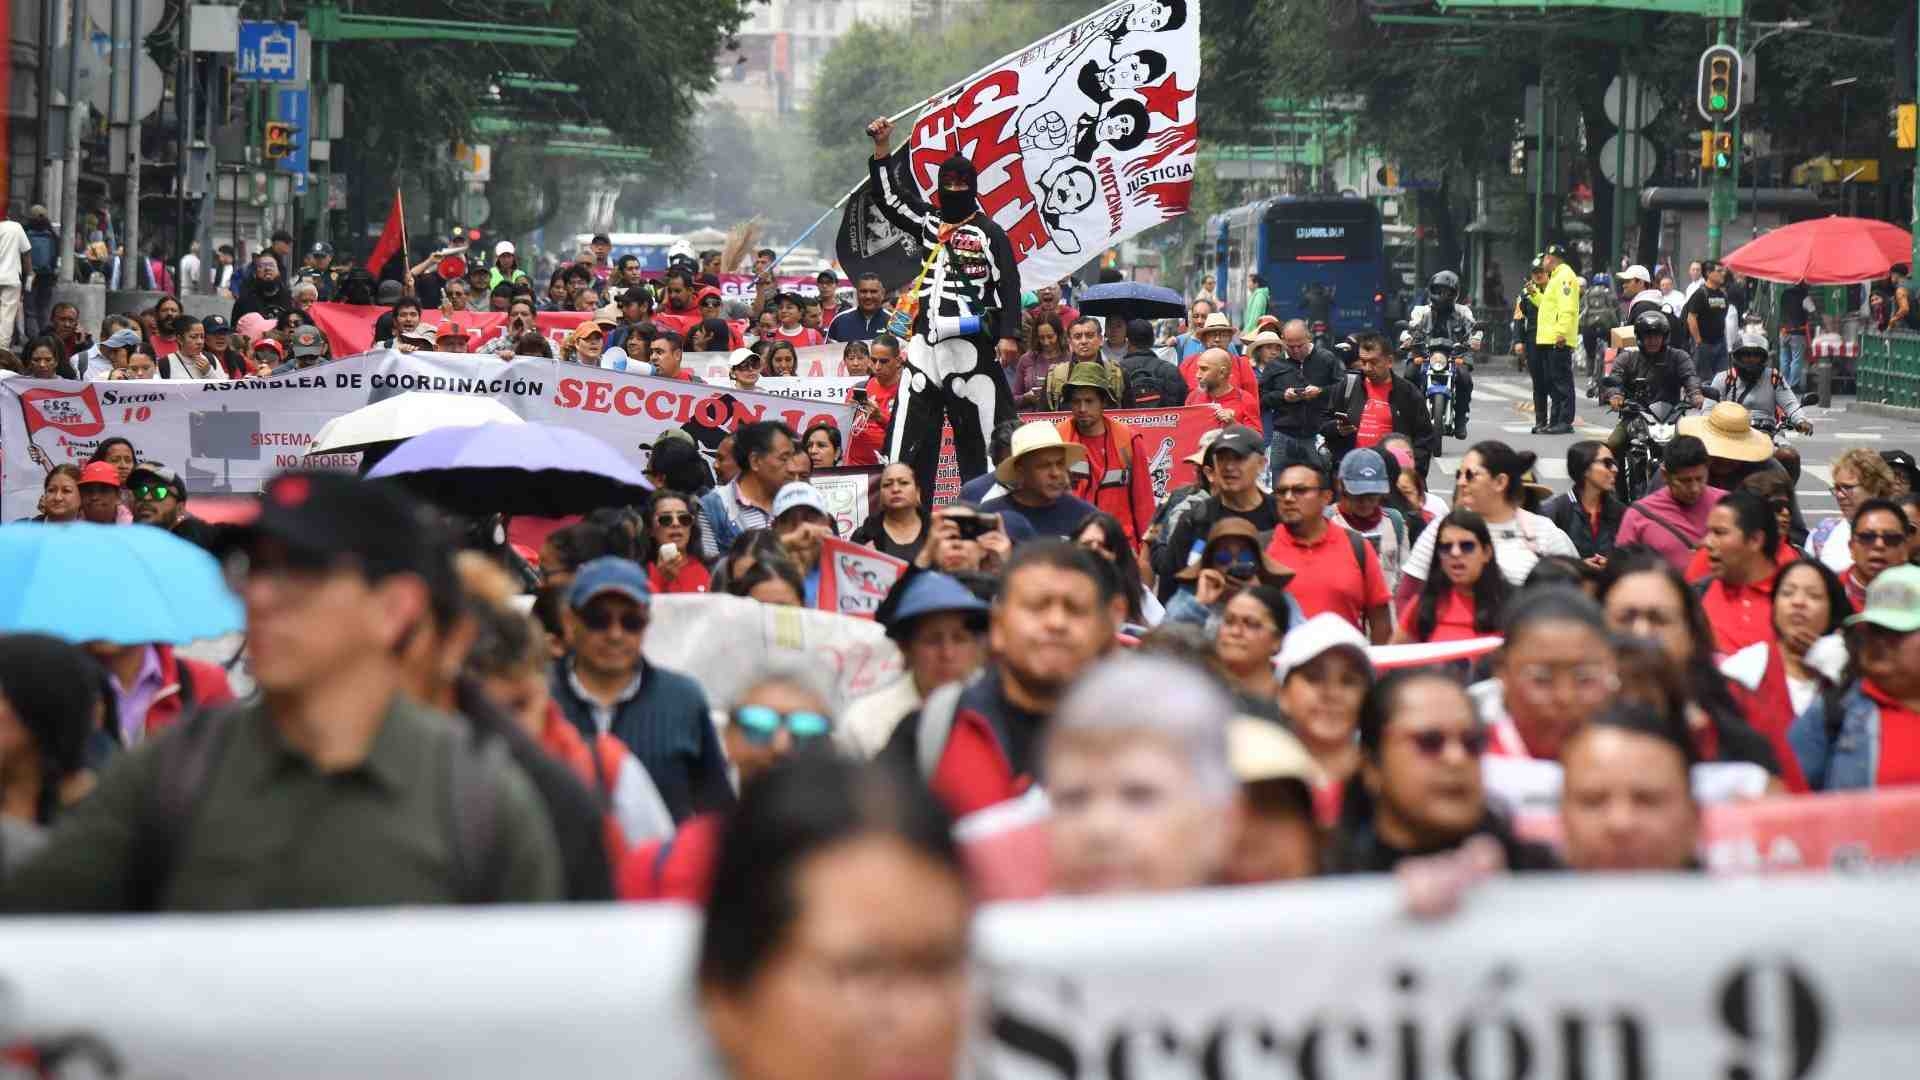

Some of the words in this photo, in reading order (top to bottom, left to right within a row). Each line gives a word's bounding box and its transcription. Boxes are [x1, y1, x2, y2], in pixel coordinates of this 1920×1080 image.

[1125, 163, 1193, 197] JUSTICIA
[335, 373, 362, 389] DE
[370, 373, 544, 396] COORDINACIÓN
[767, 386, 822, 400] ndaria
[827, 386, 849, 399] 31
[553, 377, 767, 433] SECCIÓN
[123, 406, 151, 423] 10
[251, 432, 312, 447] SISTEMA
[276, 454, 298, 468] NO
[302, 453, 359, 468] AFORES
